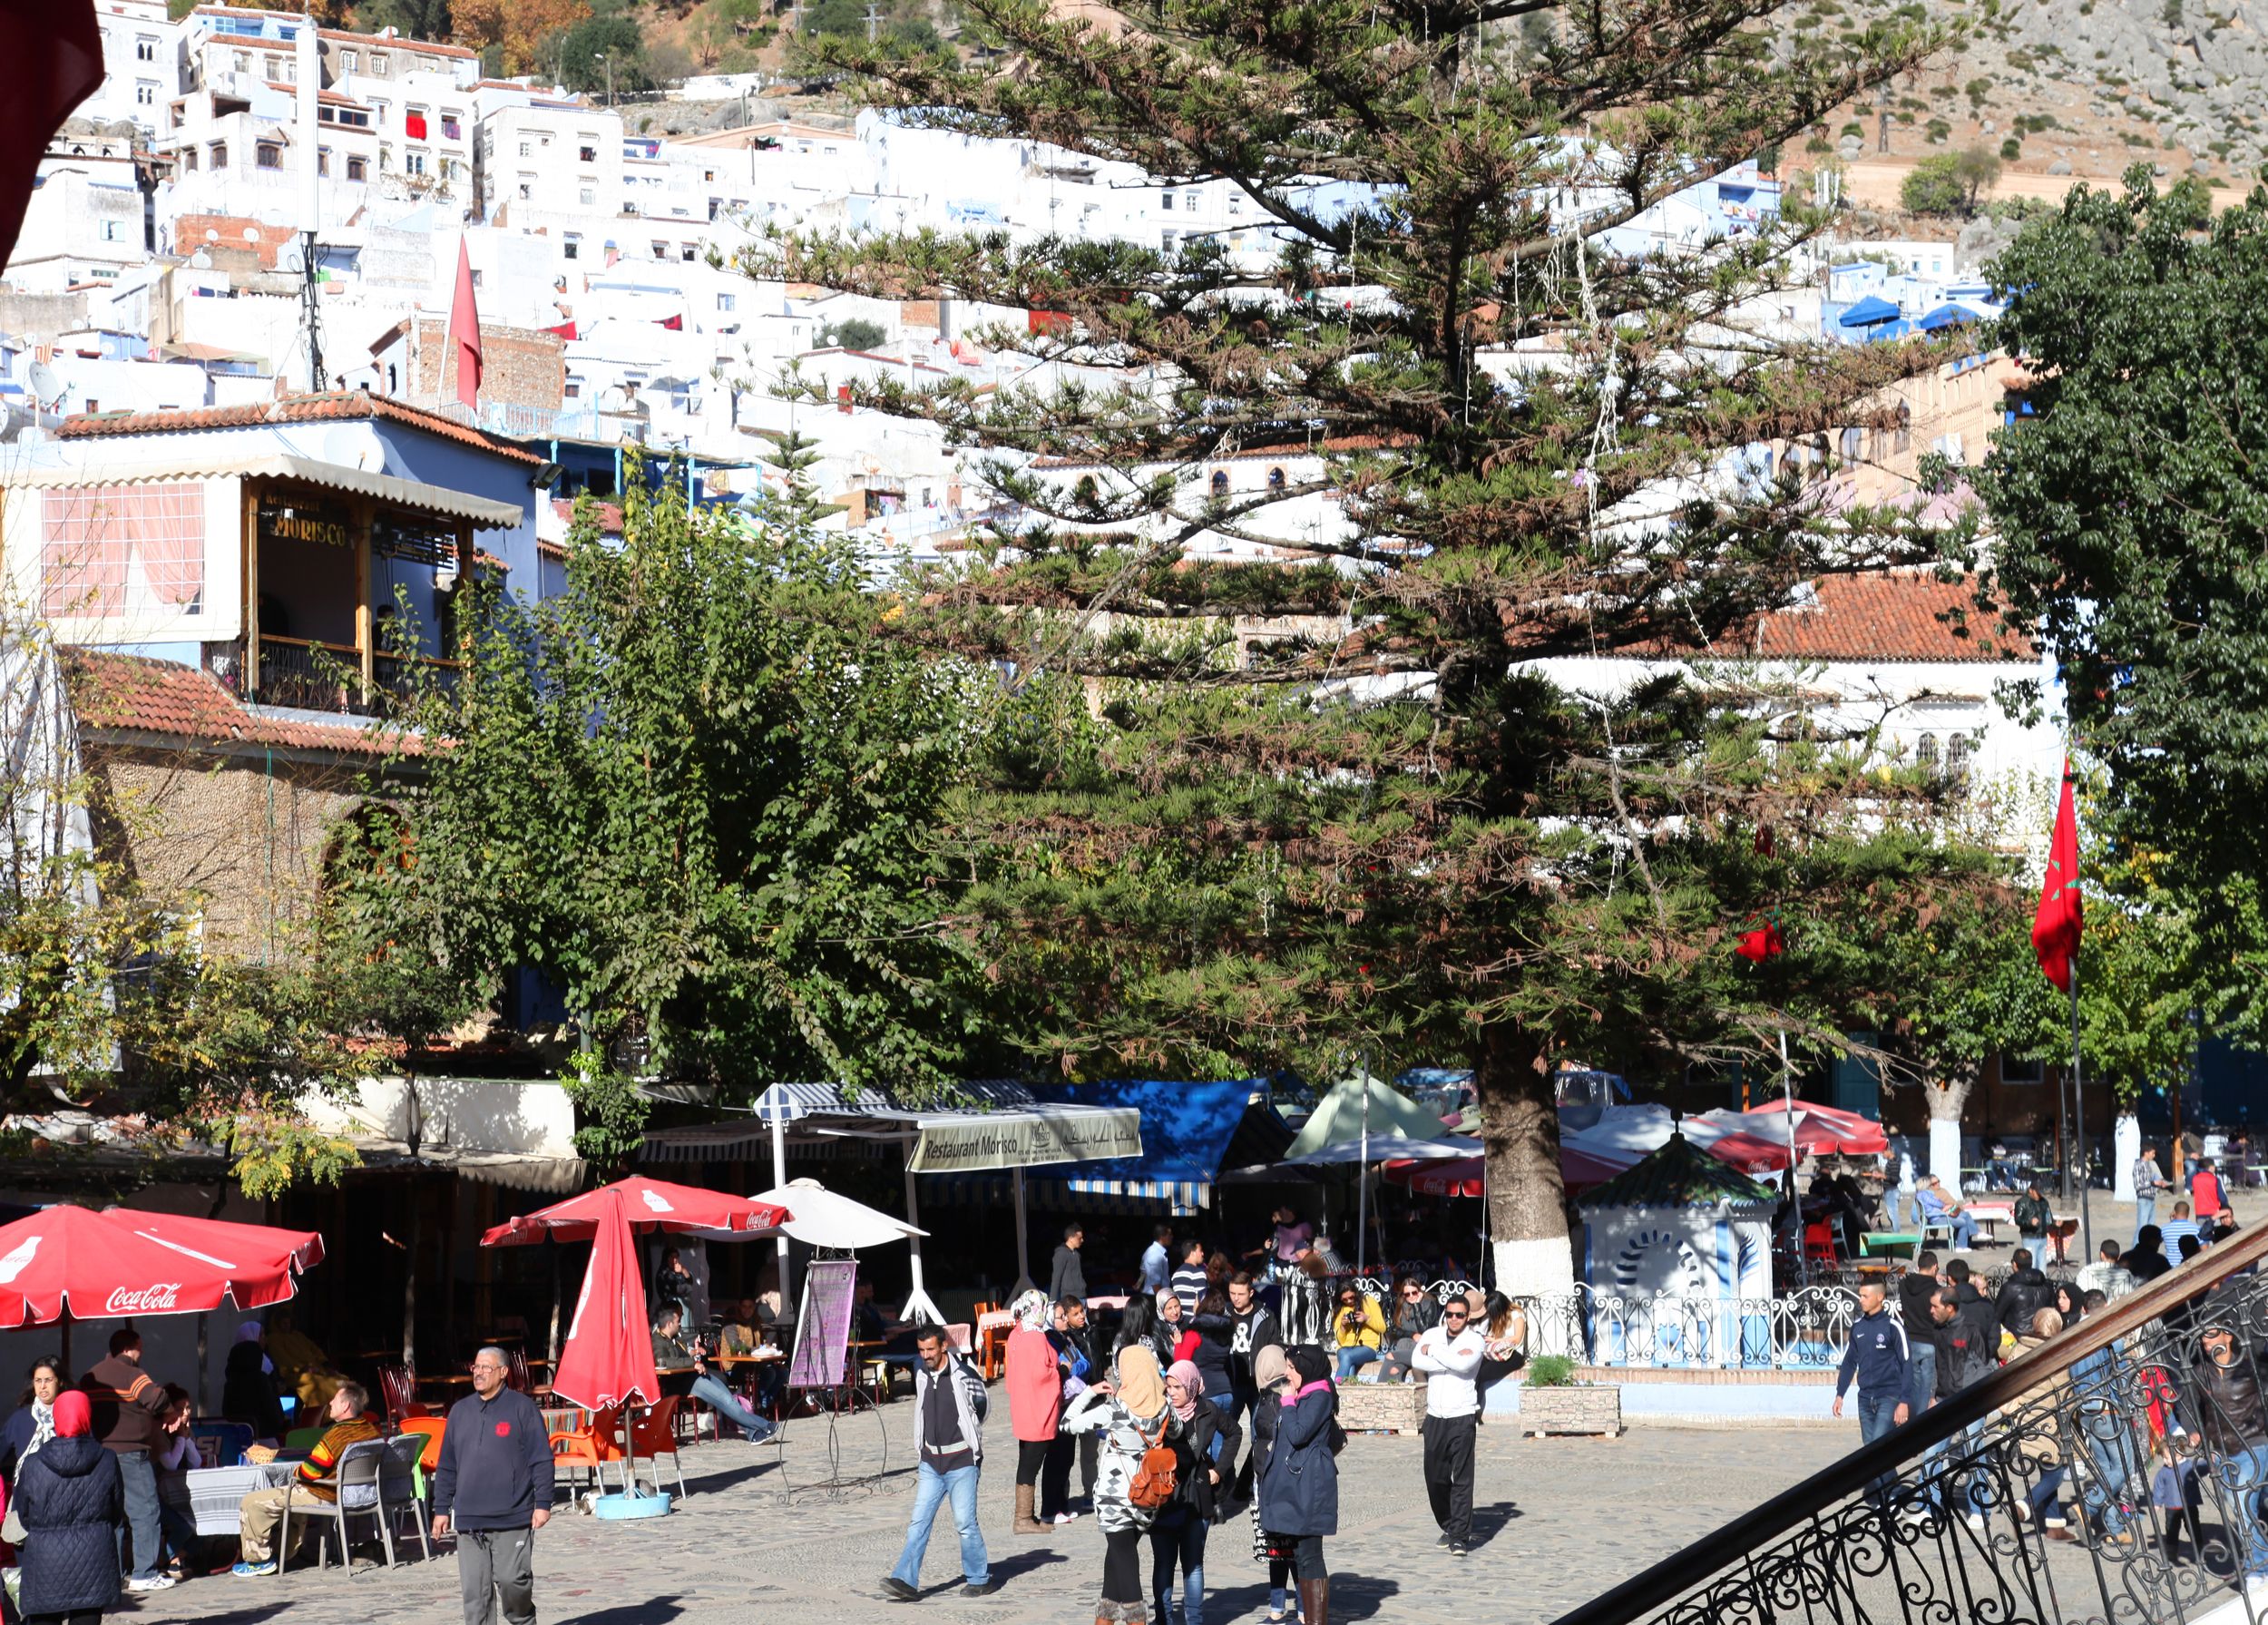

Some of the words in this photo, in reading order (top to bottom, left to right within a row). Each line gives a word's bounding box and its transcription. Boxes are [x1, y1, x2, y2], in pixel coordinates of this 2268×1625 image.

[276, 514, 346, 547] MORISCO
[924, 1138, 979, 1160] Restaurant
[981, 1134, 1017, 1157] Morisco
[106, 1283, 181, 1313] Coca-Cola
